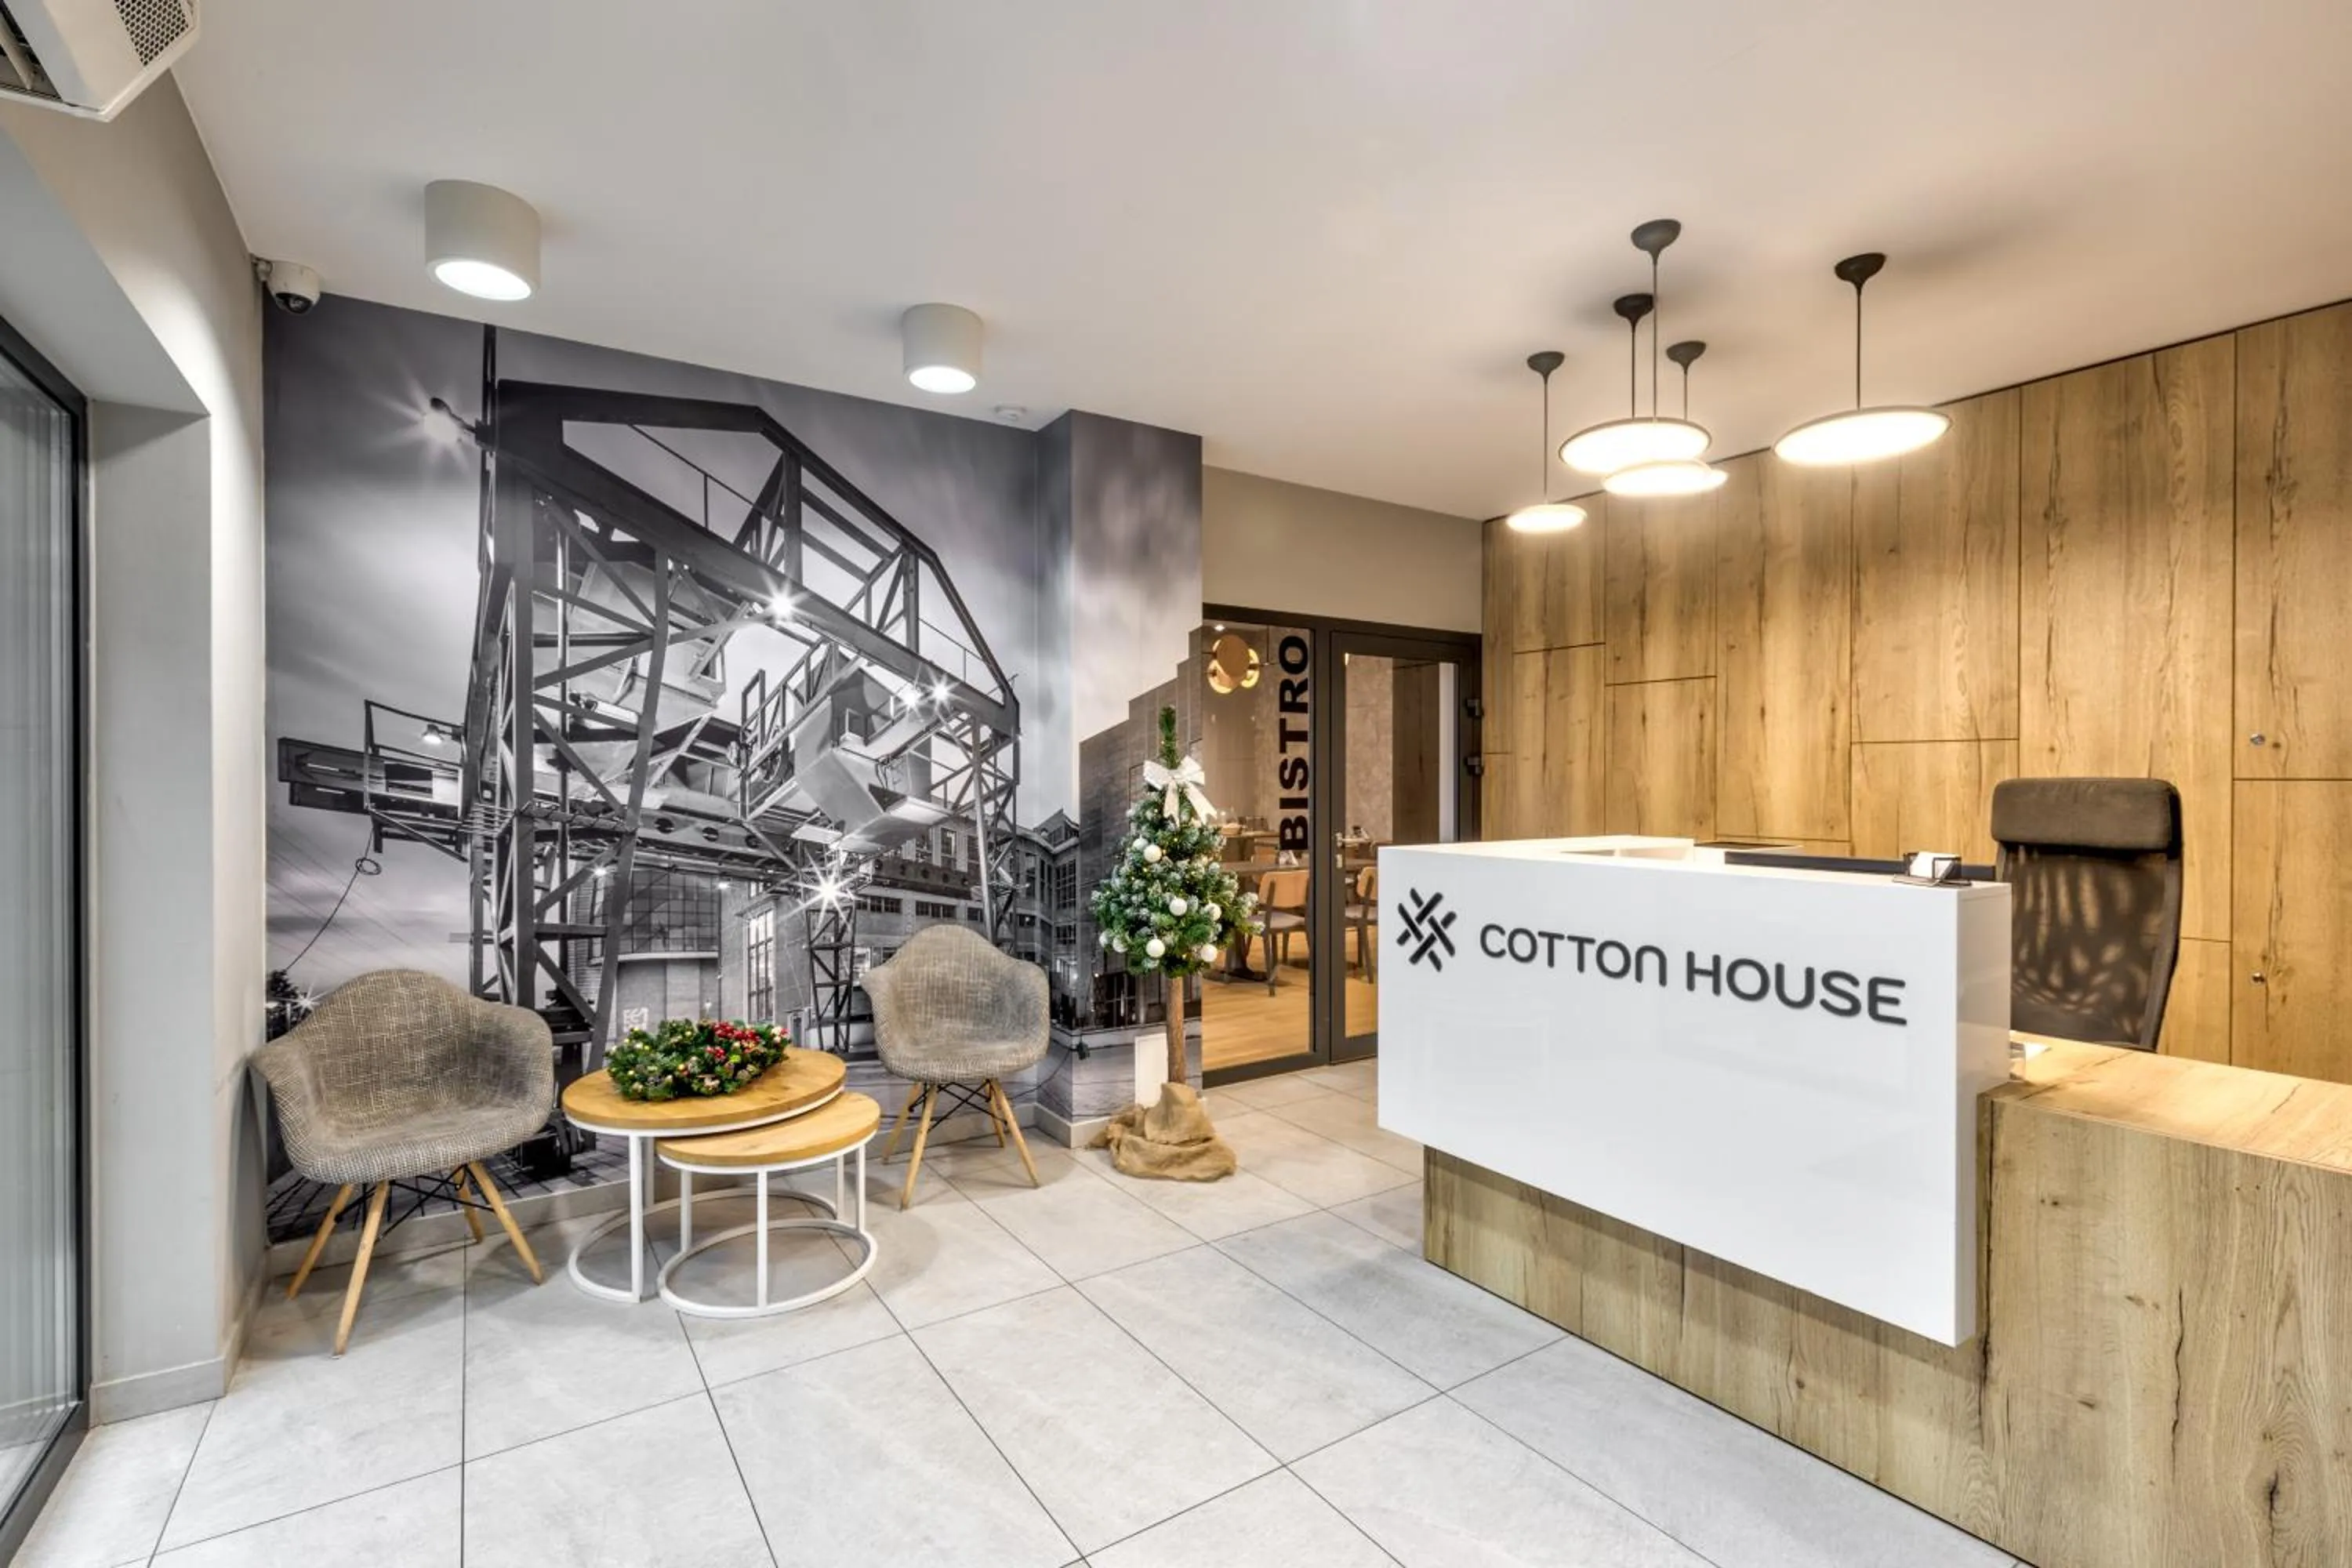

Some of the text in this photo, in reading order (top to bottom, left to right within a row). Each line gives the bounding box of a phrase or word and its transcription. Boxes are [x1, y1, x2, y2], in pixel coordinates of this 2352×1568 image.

[1279, 636, 1308, 850] BISTRO
[1479, 924, 1908, 1026] COTTON HOUSE
